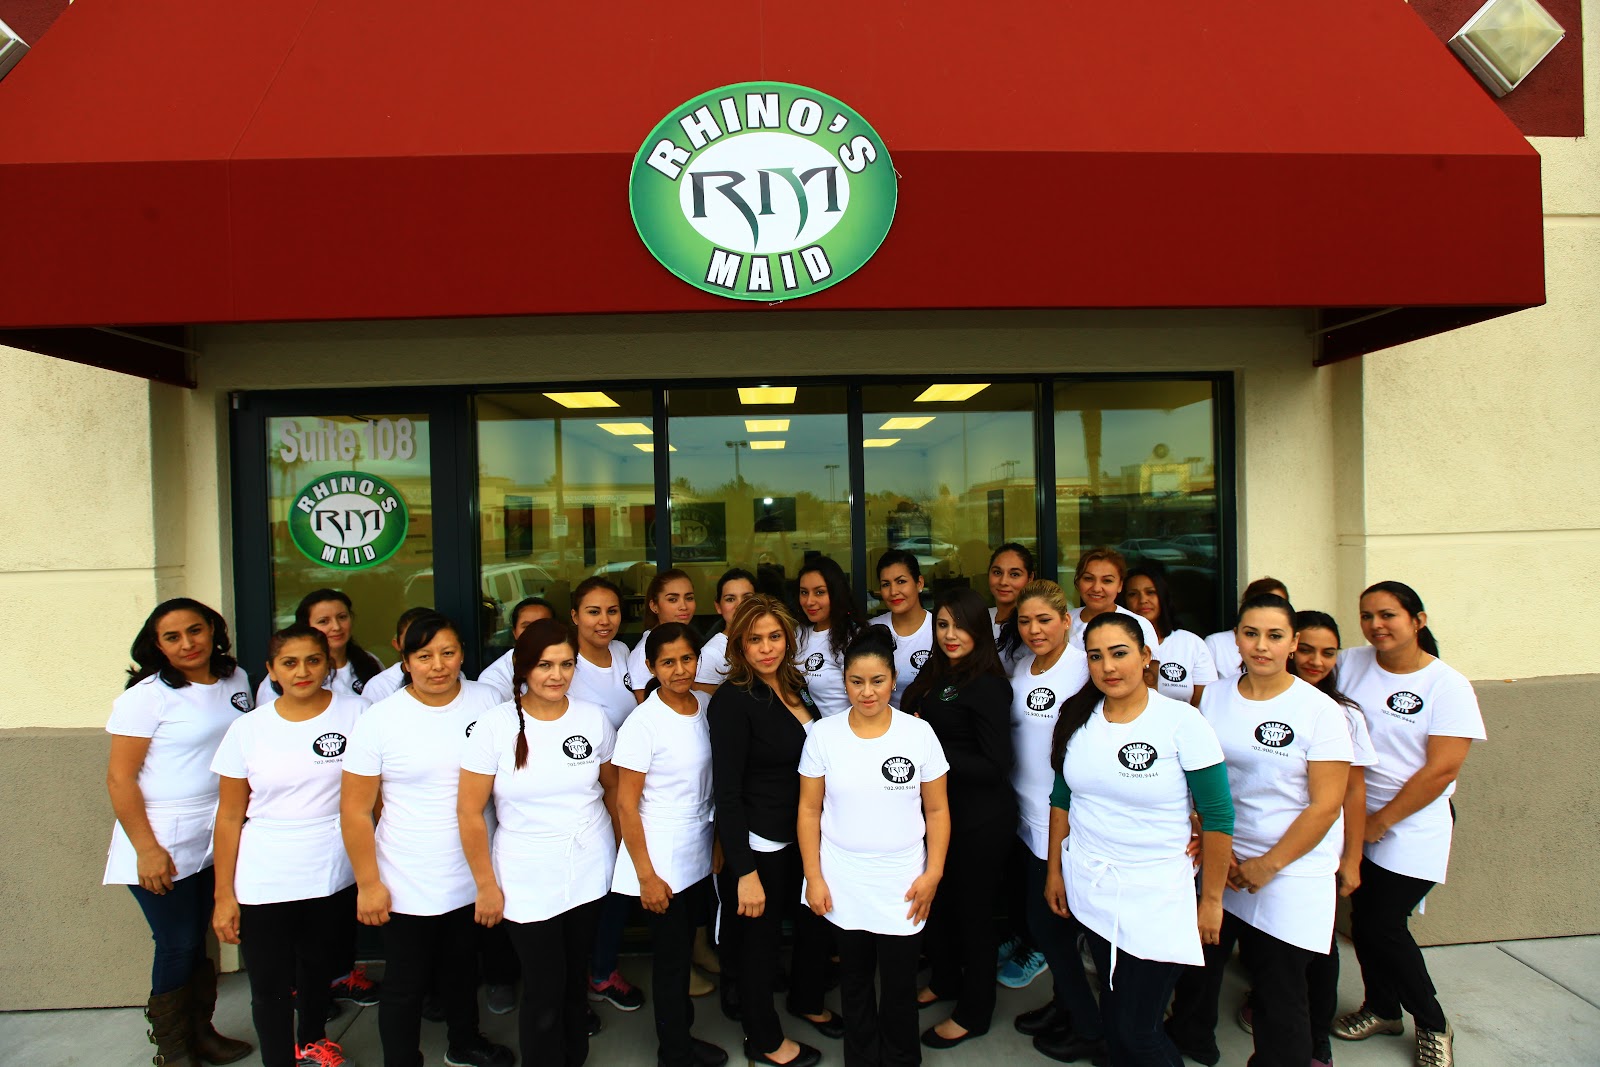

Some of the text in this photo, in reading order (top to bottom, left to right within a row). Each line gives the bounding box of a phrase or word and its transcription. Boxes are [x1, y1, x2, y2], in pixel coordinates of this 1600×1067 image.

[646, 93, 878, 181] RHINO'S
[704, 245, 833, 292] MAID
[279, 417, 415, 463] Suite 108
[296, 476, 398, 514] RHINO'S
[320, 544, 377, 564] MAID
